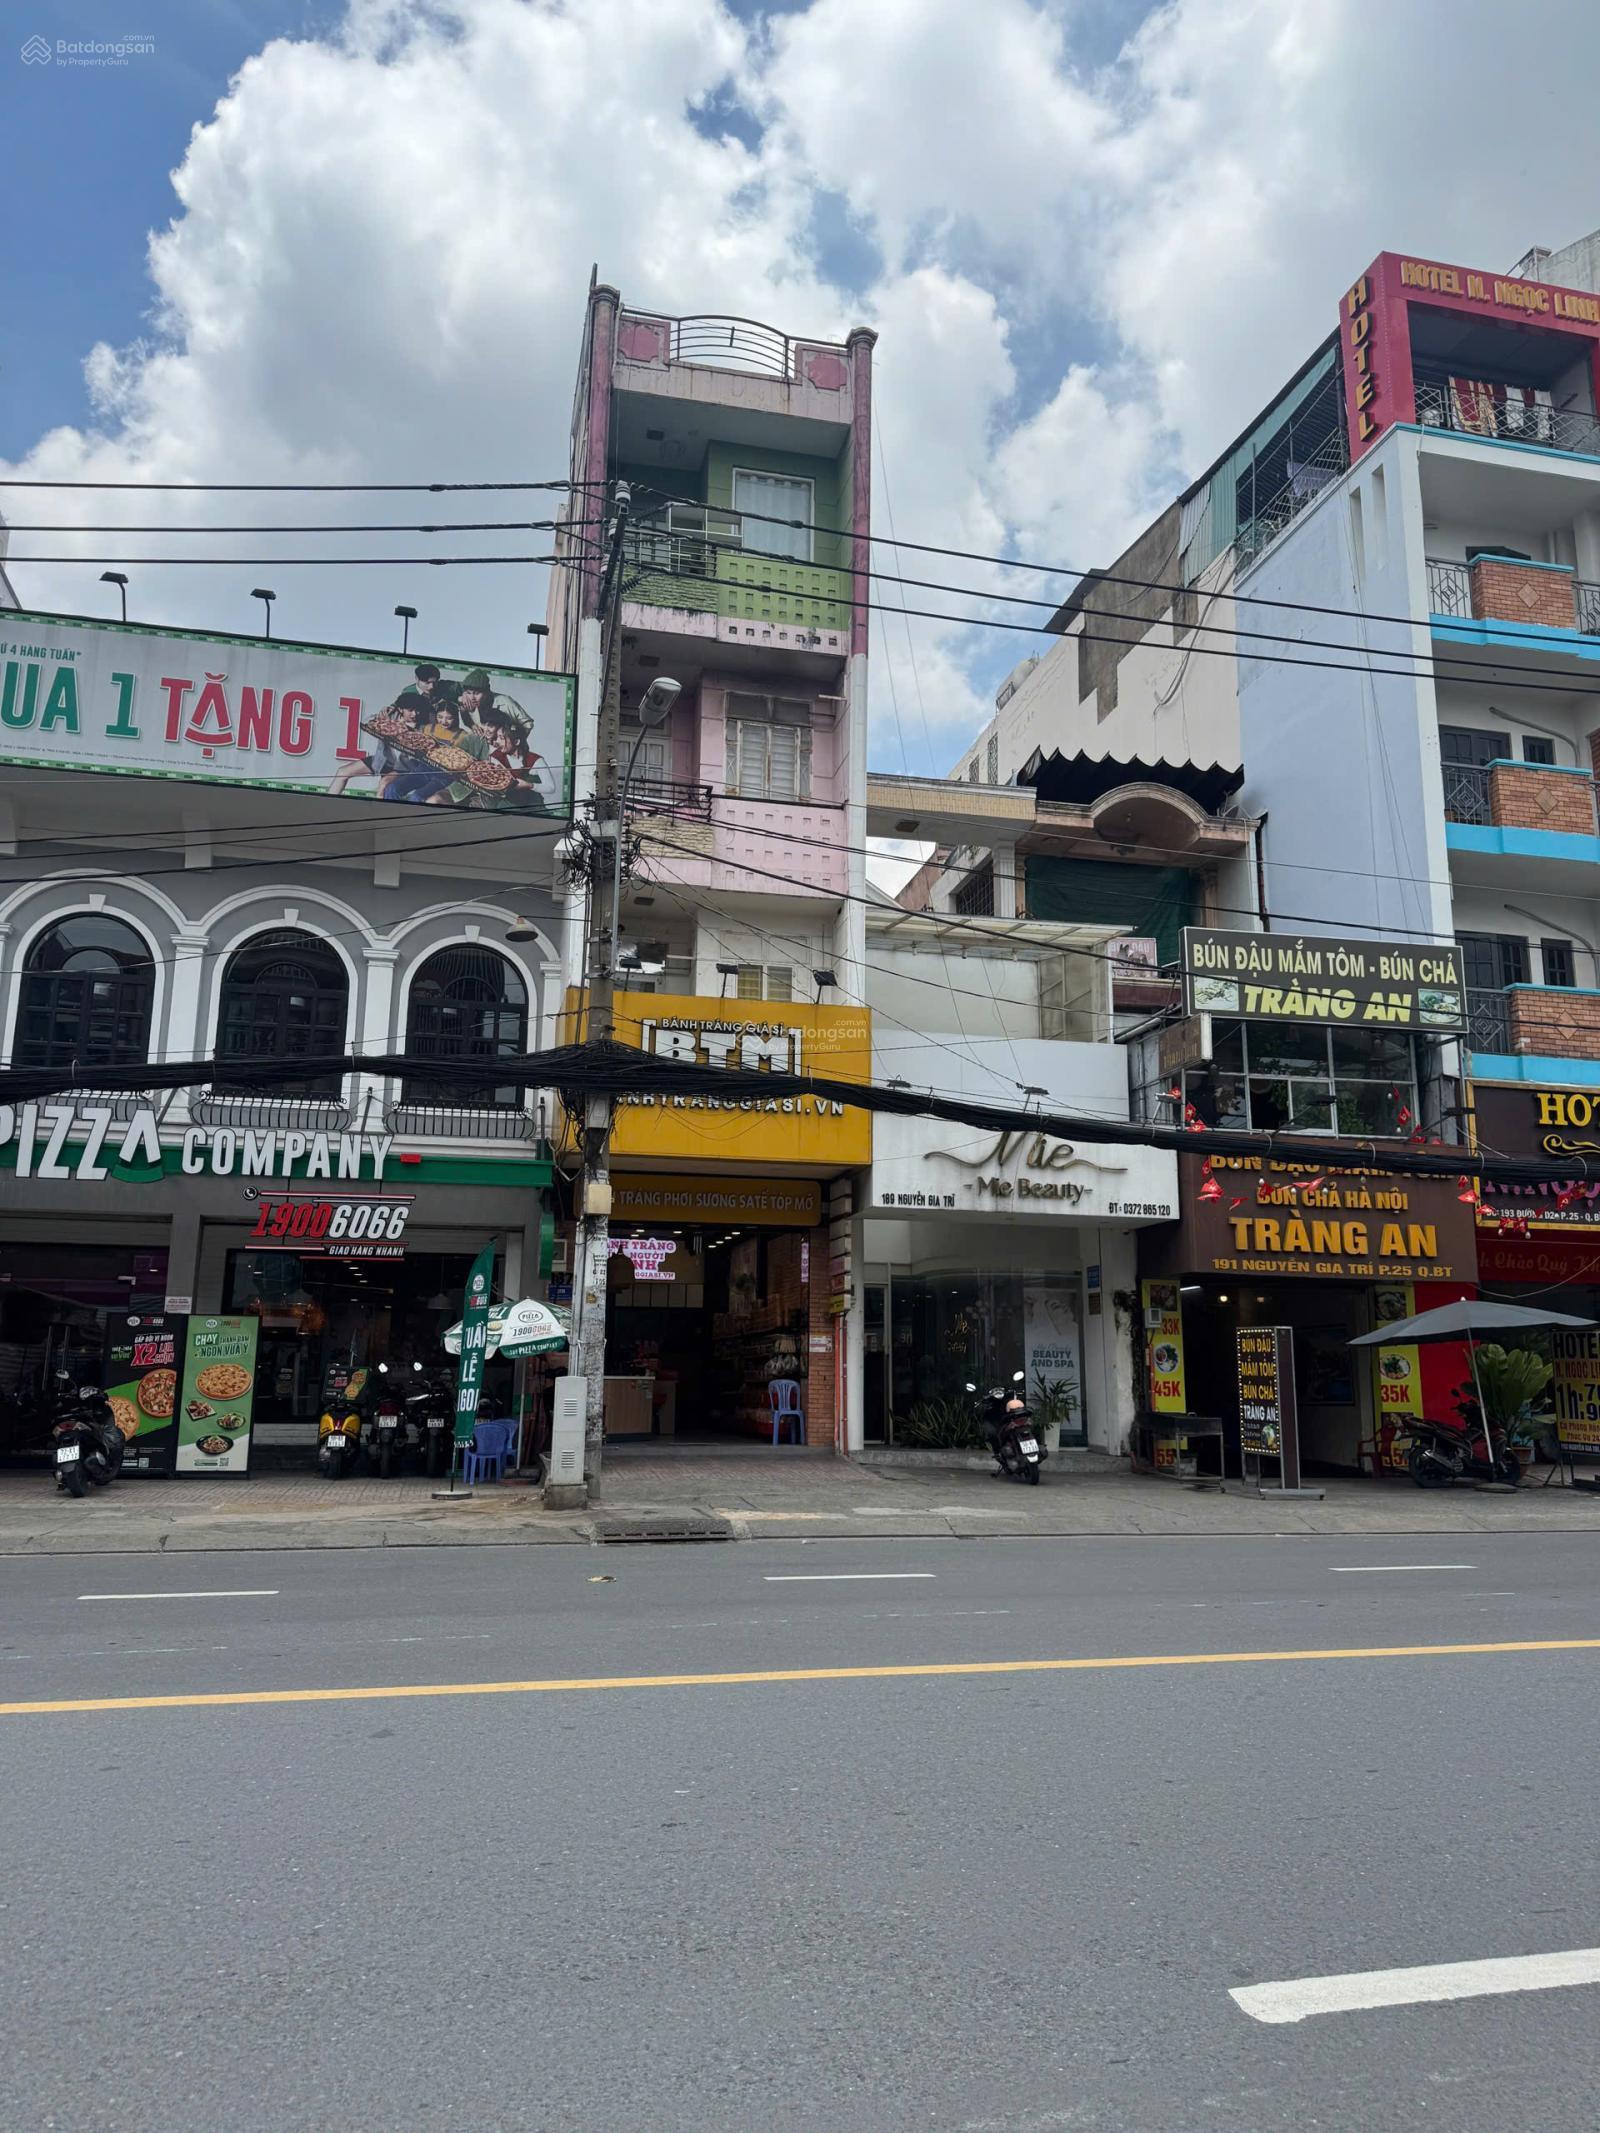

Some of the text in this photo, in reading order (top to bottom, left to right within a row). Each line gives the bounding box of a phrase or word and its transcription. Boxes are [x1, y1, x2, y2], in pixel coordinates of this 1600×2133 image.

[1400, 260, 1465, 296] HOTEL
[1494, 280, 1550, 316] NGỌC
[1554, 292, 1600, 325] LINH
[1348, 275, 1376, 442] HOTEL
[10, 644, 17, 655] 4
[105, 672, 141, 739] 1
[160, 671, 314, 759] TẶNG
[335, 696, 369, 762] 1
[1193, 938, 1229, 970] BÚN
[1235, 941, 1273, 978] ĐẬU
[1278, 938, 1322, 975] MẮM
[1326, 947, 1365, 978] TÔM
[1380, 950, 1414, 981] BÚN
[1419, 953, 1458, 985] CHẢ
[1244, 978, 1412, 1023] TRÀNG AN
[181, 1126, 394, 1181] COMPANY
[882, 1193, 895, 1205] 189
[928, 1195, 940, 1207] GIA
[976, 1177, 1012, 1197] Mie
[1018, 1178, 1084, 1206] Beauty
[1302, 1182, 1341, 1209] CHẢ
[1345, 1186, 1372, 1209] HÀ
[1375, 1187, 1409, 1214] NỘI
[249, 1202, 410, 1240] 19006066
[1500, 1208, 1514, 1217] 193
[1229, 1209, 1438, 1259] TRÀNG AN
[329, 1245, 405, 1258] GIAO HÀNG NHANH
[1212, 1257, 1453, 1278] 191 NGUYỄN GIA TRÍ P.25 Q.BT
[1161, 1318, 1180, 1335] 33K
[130, 1342, 158, 1367] X2
[1032, 1350, 1072, 1359] BEAUTY
[1553, 1331, 1600, 1360] HOTE
[1031, 1359, 1075, 1369] AND SPA
[1154, 1381, 1181, 1397] 45K
[1243, 1380, 1257, 1399] BÚN
[1380, 1384, 1411, 1403] 35K
[1244, 1403, 1277, 1422] TRÀNG AN
